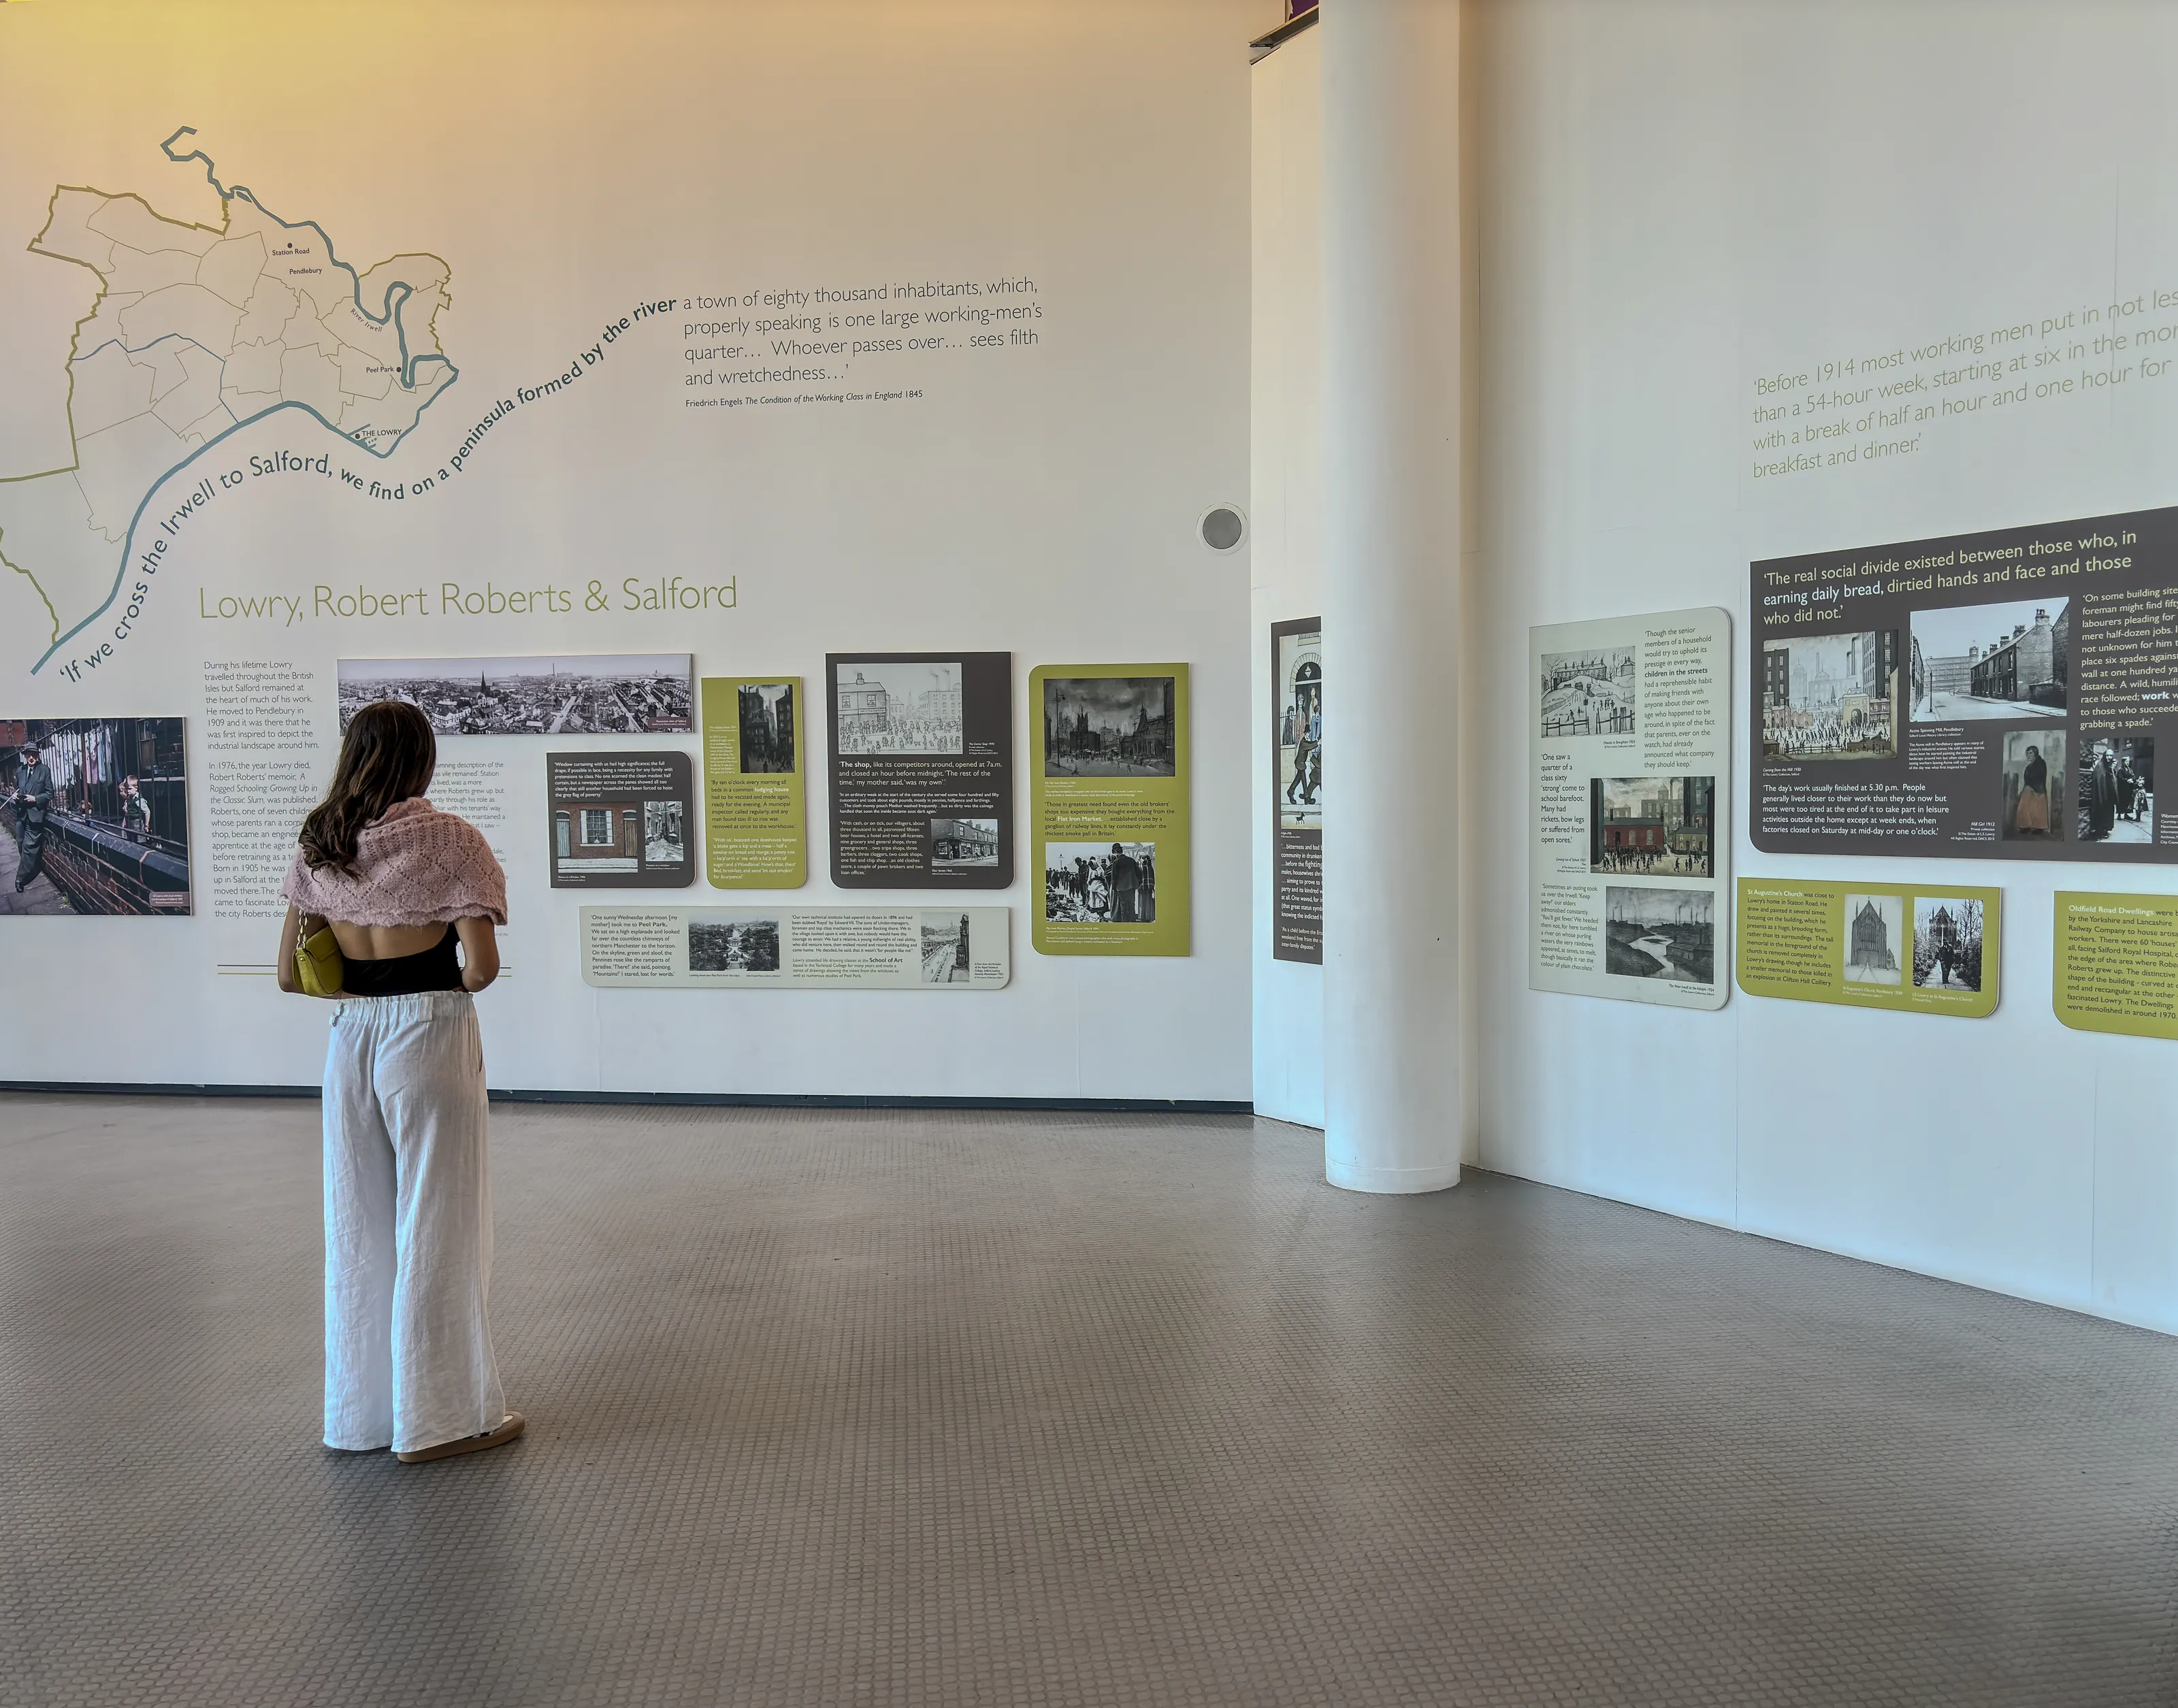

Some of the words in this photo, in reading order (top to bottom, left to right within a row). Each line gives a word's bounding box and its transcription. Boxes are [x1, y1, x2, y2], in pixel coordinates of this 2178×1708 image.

[683, 299, 692, 309] a
[696, 295, 736, 308] town
[743, 290, 760, 306] of
[764, 289, 809, 309] eighty
[814, 283, 886, 302] thousand
[894, 280, 981, 298] inhabitants,
[986, 276, 1037, 293] which,
[351, 308, 363, 323] River
[364, 321, 383, 332] Irwell
[685, 316, 749, 339] properly
[755, 314, 821, 335] speaking
[829, 312, 839, 327] is
[845, 314, 875, 327] one
[881, 309, 918, 329] large
[924, 301, 1041, 325] working-men's
[770, 340, 847, 355] Whoever
[853, 339, 902, 357] passes
[970, 334, 1003, 346] sees
[1009, 328, 1037, 344] filth
[1754, 374, 1807, 395] 'Before
[1817, 358, 1855, 382] 1914
[1862, 349, 1904, 373] most
[1910, 333, 1983, 361] working
[1991, 324, 2032, 344] men
[2041, 311, 2074, 339] put
[2083, 305, 2098, 324] in
[2109, 295, 2145, 319] not
[685, 369, 712, 385] and
[1753, 406, 1785, 423] than
[1791, 404, 1800, 416] a
[1806, 389, 1872, 412] 54-hour
[1877, 373, 1927, 398] week,
[1933, 360, 2002, 387] starting
[2009, 353, 2027, 372] at
[2034, 346, 2060, 366] six
[2068, 340, 2083, 359] in
[2092, 333, 2126, 357] the
[685, 398, 717, 407] Friedrich
[720, 397, 742, 407] Engels
[760, 395, 791, 404] Condition
[794, 395, 802, 404] of
[803, 395, 813, 403] the
[815, 393, 844, 403] Working
[846, 392, 863, 400] Class
[875, 391, 902, 401] England
[905, 390, 924, 398] 1845
[1753, 429, 1785, 450] with
[1791, 431, 1800, 444] a
[1805, 417, 1850, 441] break
[1856, 411, 1874, 431] of
[1879, 404, 1911, 427] half
[1915, 406, 1934, 421] an
[1943, 395, 1987, 416] hour
[1992, 381, 2027, 406] and
[2035, 379, 2073, 397] one
[2081, 367, 2132, 389] hour
[2139, 357, 2171, 378] for
[1753, 453, 1821, 478] breakfast
[1827, 444, 1856, 465] and
[1863, 432, 1921, 459] dinner.'
[60, 660, 81, 683] 'If
[84, 643, 113, 669] we
[115, 582, 148, 640] cross
[142, 540, 167, 574] the
[161, 478, 215, 536] Irwell
[220, 470, 243, 489] to
[249, 450, 333, 478] Salford,
[341, 467, 363, 490] we
[370, 481, 404, 500] find
[412, 476, 435, 495] on
[438, 468, 449, 480] a
[451, 399, 516, 472] peninsula
[517, 361, 583, 404] formed
[581, 343, 604, 366] by
[602, 316, 630, 344] the
[633, 298, 677, 322] river
[1763, 572, 1789, 585] 'The
[1795, 567, 1816, 582] real
[1821, 562, 1855, 579] social
[1861, 558, 1899, 574] divide
[1904, 551, 1953, 570] existed
[1960, 546, 2022, 563] between
[2028, 540, 2072, 555] those
[2078, 533, 2117, 549] who,
[2122, 530, 2136, 544] in
[1763, 590, 1807, 606] earning
[1812, 585, 1839, 602] daily
[1844, 580, 1883, 597] bread,
[1887, 574, 1932, 592] dirtied
[1938, 570, 1977, 587] hands
[1983, 565, 2009, 582] and
[2015, 564, 2045, 579] face
[2051, 557, 2079, 575] and
[2085, 556, 2131, 571] those
[200, 587, 302, 627] Lowry,
[314, 585, 429, 617] Robert
[442, 582, 571, 614] Roberts
[585, 580, 610, 611] &
[623, 575, 736, 610] Salford
[1763, 611, 1789, 625] who
[1793, 608, 1812, 621] did
[1817, 604, 1842, 620] not.'
[204, 661, 228, 670] During
[242, 660, 267, 668] lifetime
[270, 661, 292, 670] Lowry
[854, 761, 871, 769] shop,
[1778, 784, 1791, 793] day's
[1812, 784, 1832, 793] usually
[1902, 783, 1925, 792] People
[2118, 907, 2153, 917] Dwellings
